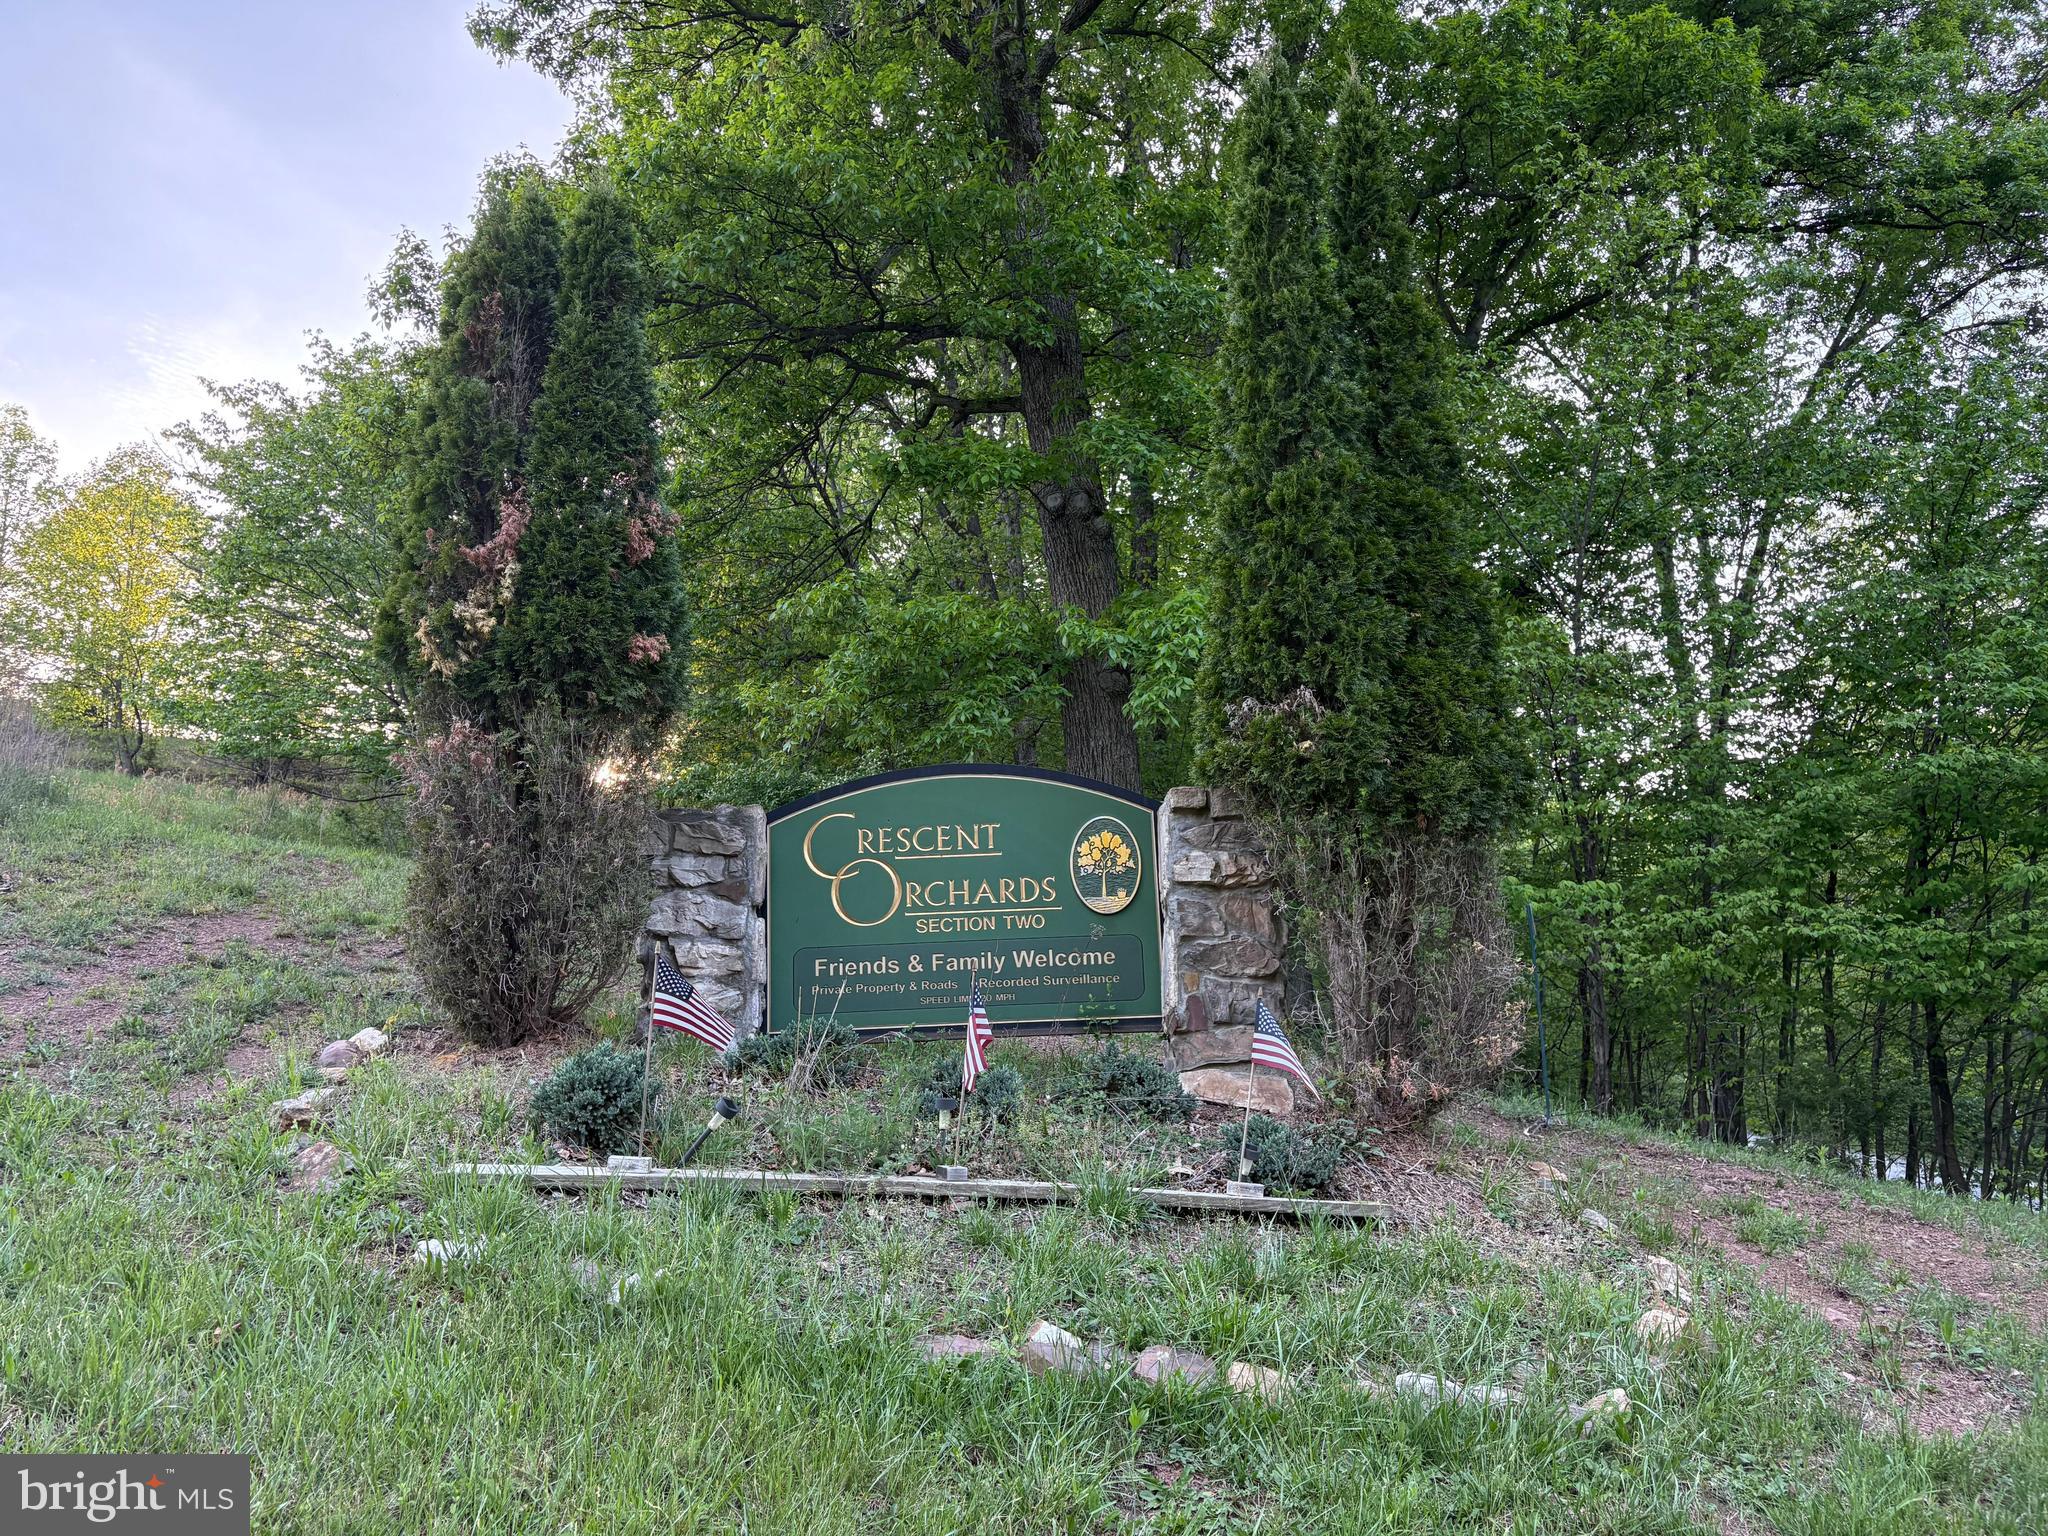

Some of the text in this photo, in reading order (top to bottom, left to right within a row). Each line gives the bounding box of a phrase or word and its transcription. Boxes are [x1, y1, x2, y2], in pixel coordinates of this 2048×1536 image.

[803, 812, 1002, 880] CRESCENT
[831, 858, 1058, 927] ORCHARDS
[916, 913, 1046, 934] SECTION TWO
[814, 948, 1117, 977] Friends & Family Welcome
[811, 973, 1120, 996] Private Property & Roads Recorded Surveillance
[920, 996, 950, 1005] SPEED
[954, 995, 973, 1004] LIM
[995, 993, 1016, 1002] MPH
